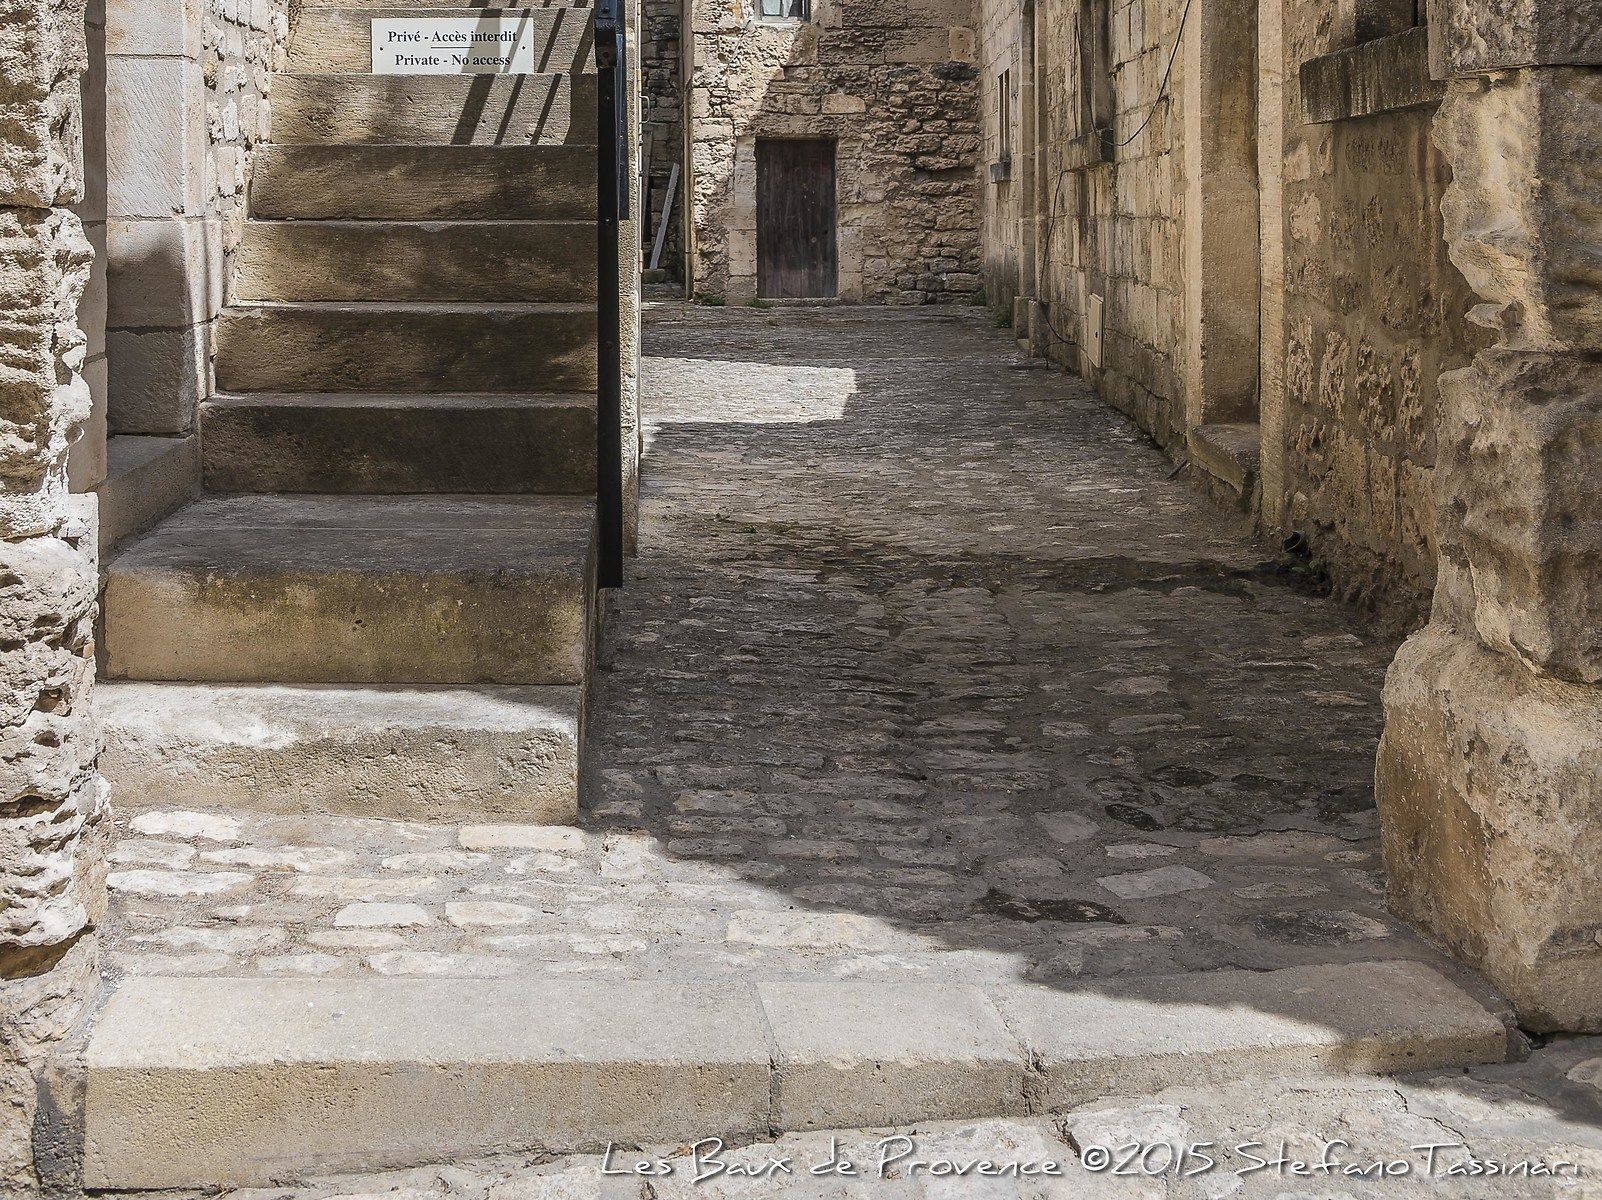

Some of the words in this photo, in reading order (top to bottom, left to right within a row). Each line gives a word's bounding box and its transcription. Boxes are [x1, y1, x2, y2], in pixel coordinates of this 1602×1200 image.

[387, 30, 421, 43] Privé
[431, 30, 467, 43] Accès
[470, 30, 518, 43] interdit
[395, 54, 440, 66] Private
[452, 54, 469, 66] No
[472, 57, 511, 66] access
